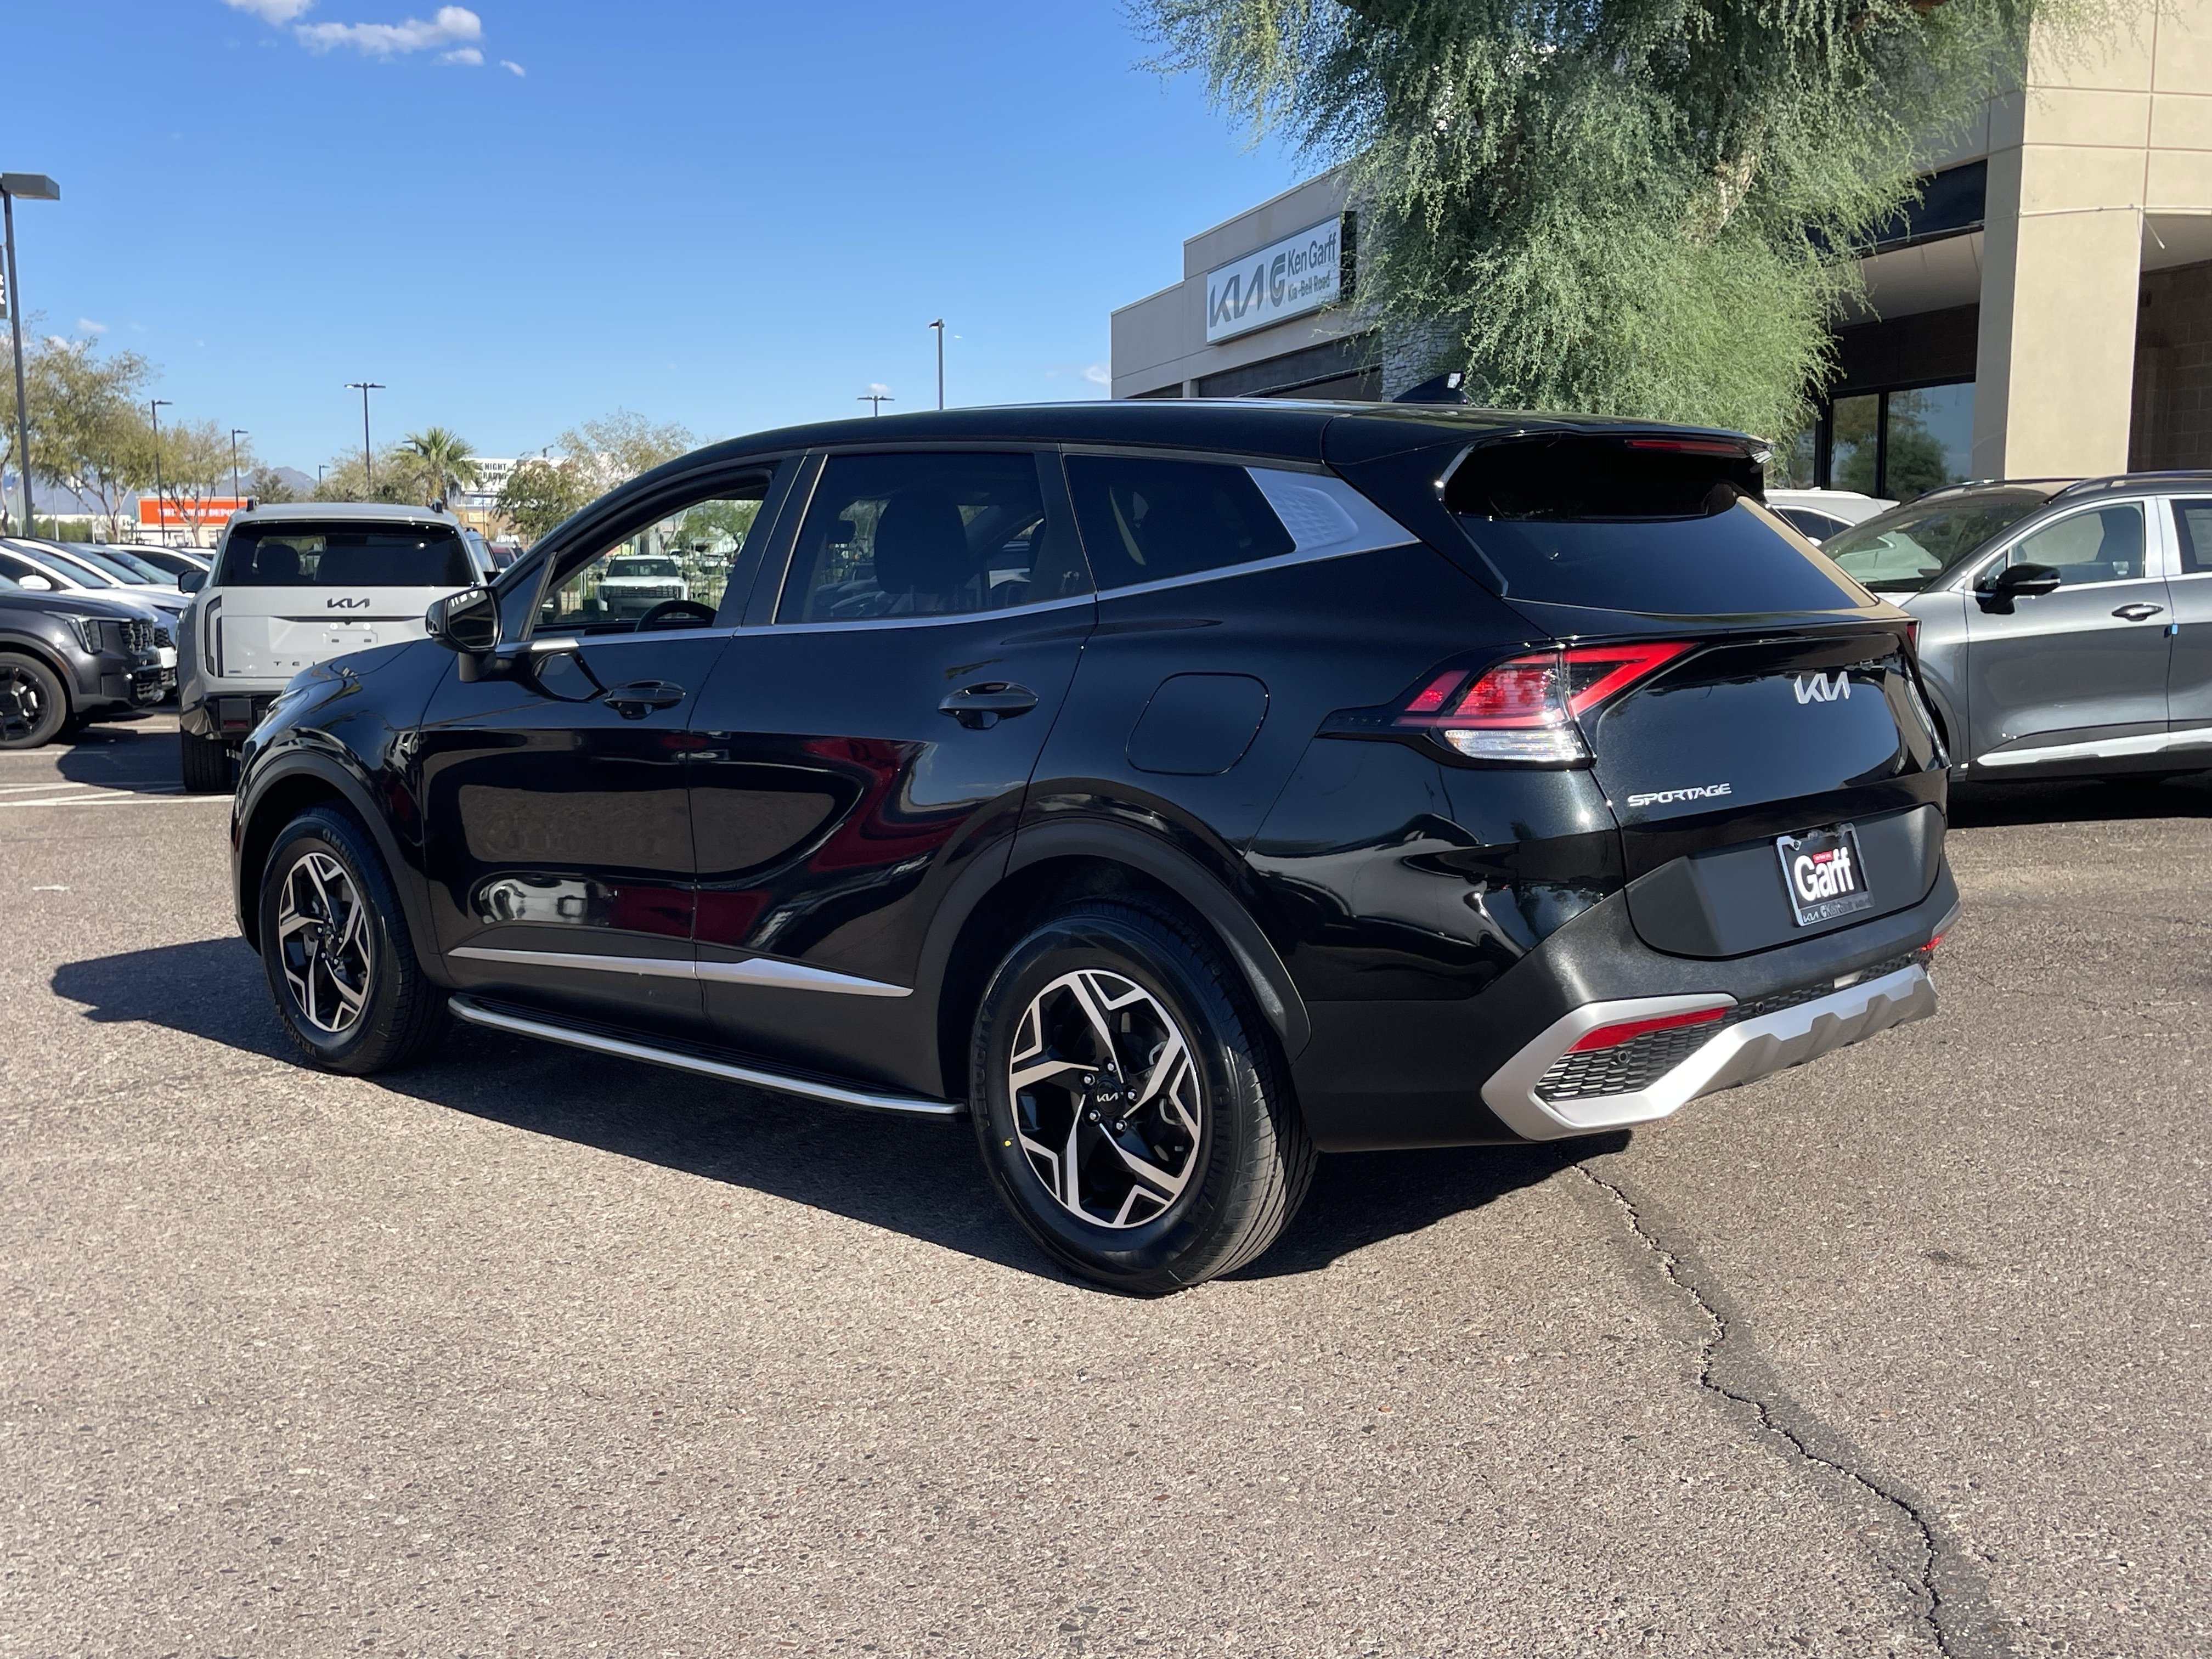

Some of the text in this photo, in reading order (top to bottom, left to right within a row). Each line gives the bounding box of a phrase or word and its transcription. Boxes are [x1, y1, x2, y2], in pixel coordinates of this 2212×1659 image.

[1288, 232, 1337, 277] Ken Garff
[1209, 264, 1264, 328] KIA
[327, 597, 370, 608] KIA
[1794, 671, 1852, 704] KIA
[1627, 782, 1733, 807] SPORTAGE
[1794, 847, 1854, 901] Garff
[1097, 1092, 1119, 1103] KIA
